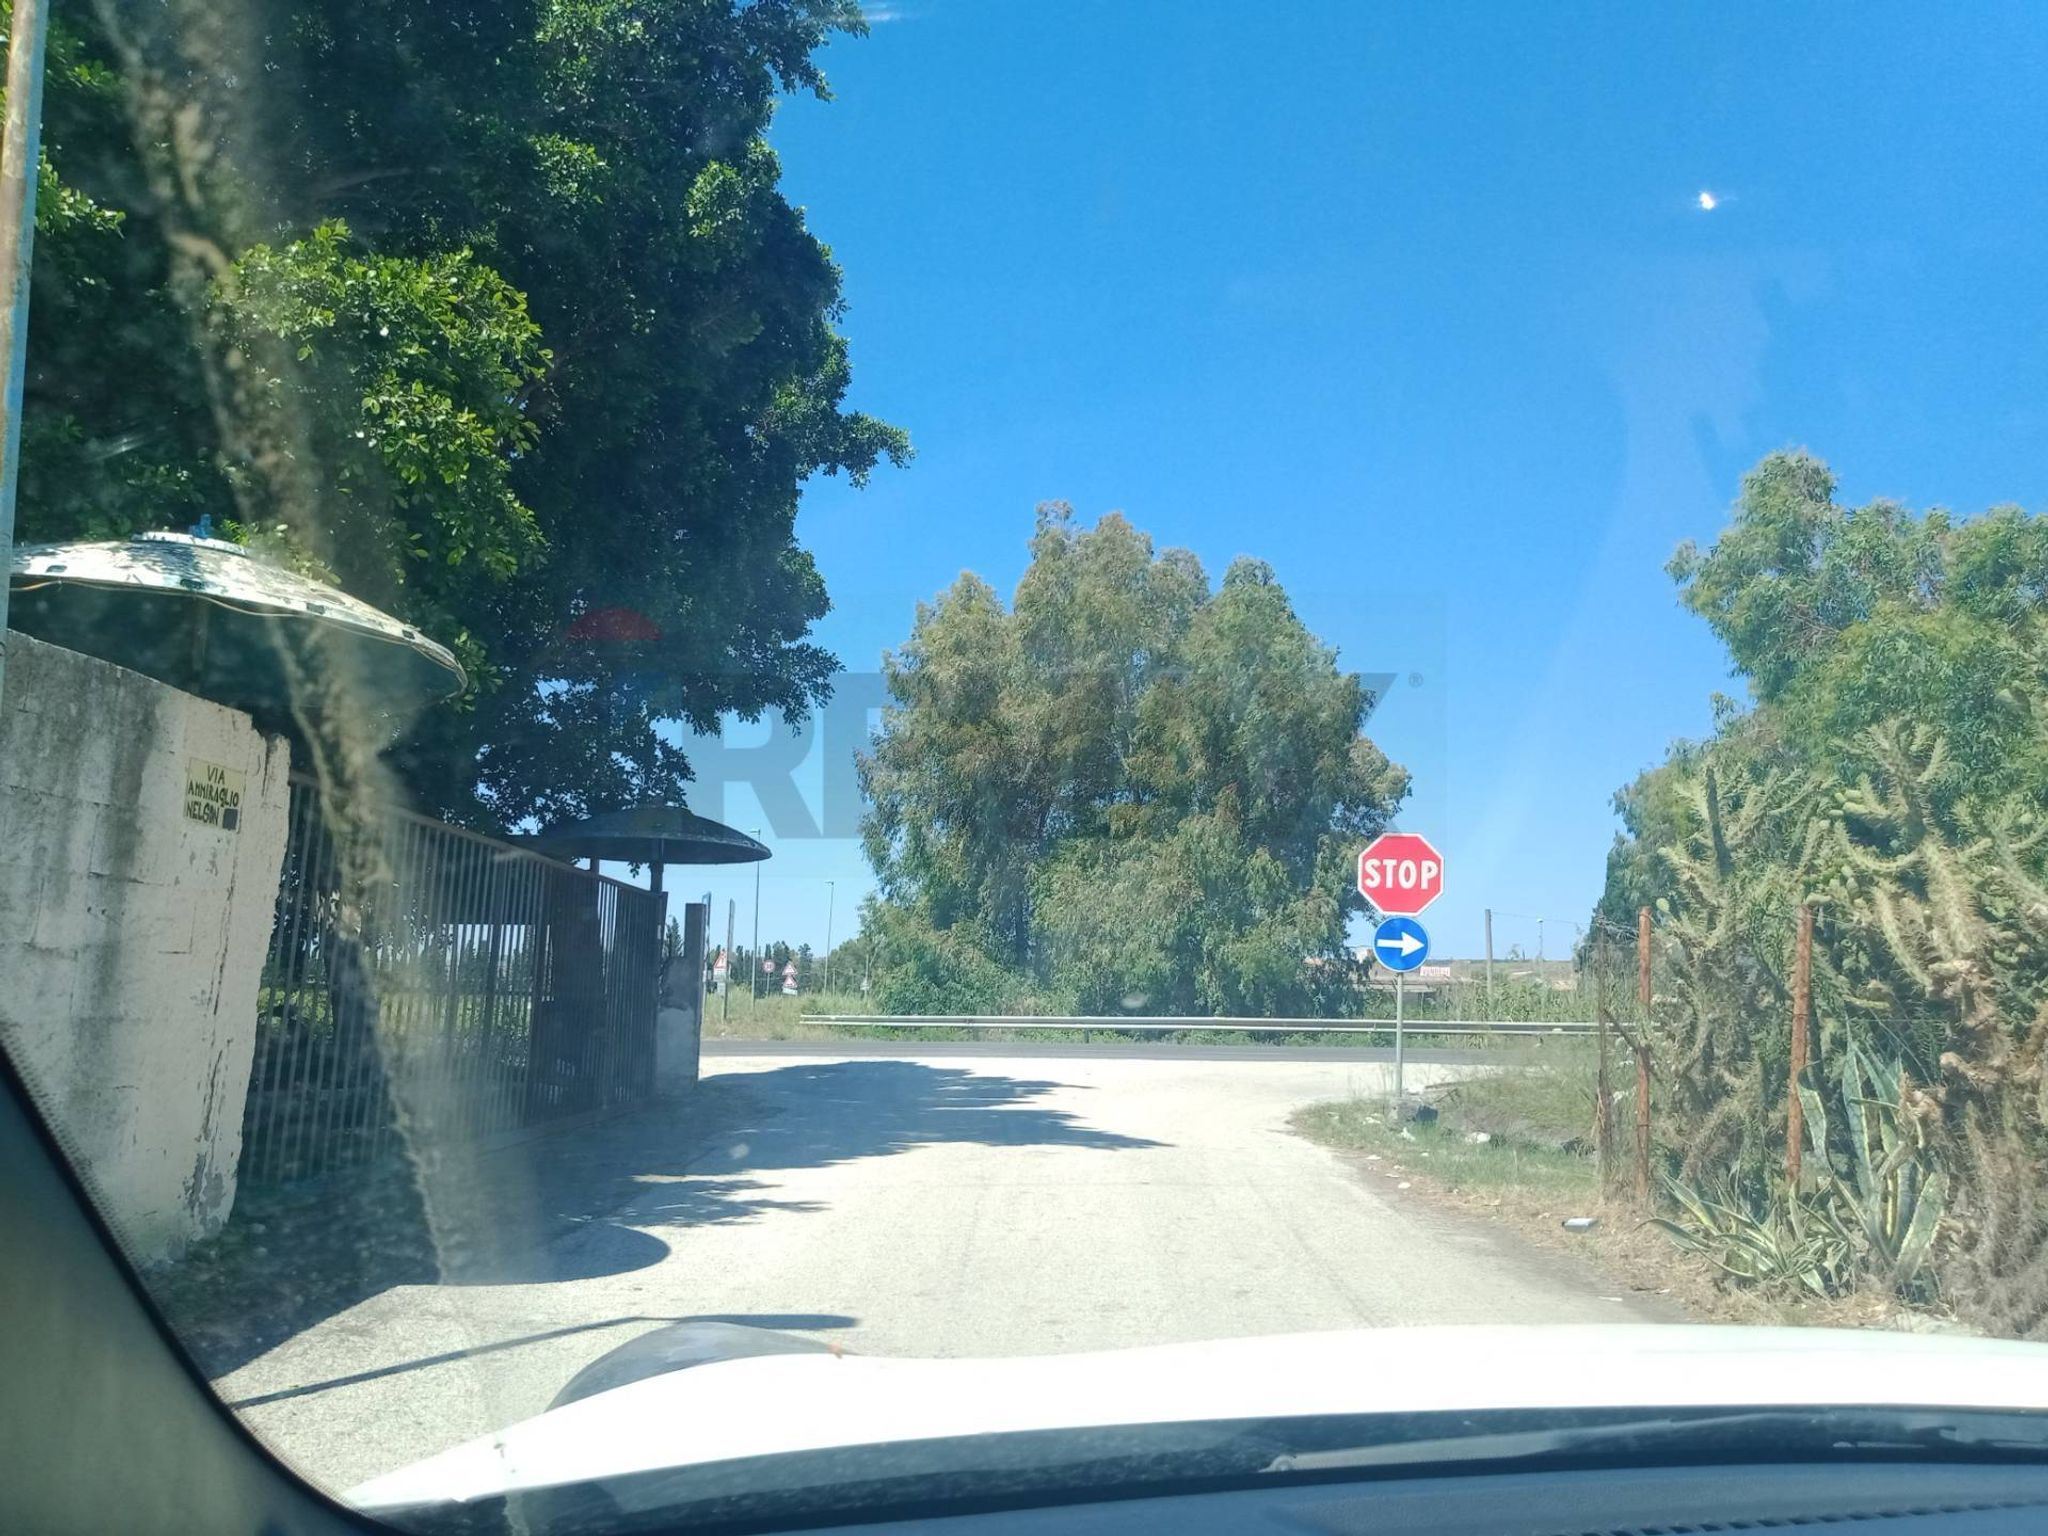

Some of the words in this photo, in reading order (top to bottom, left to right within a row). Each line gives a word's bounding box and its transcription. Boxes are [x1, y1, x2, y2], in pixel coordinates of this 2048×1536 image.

[207, 765, 225, 784] VIA
[187, 780, 240, 808] AMMIRAGLIO
[186, 801, 220, 826] NELSON
[1364, 858, 1439, 890] STOP
